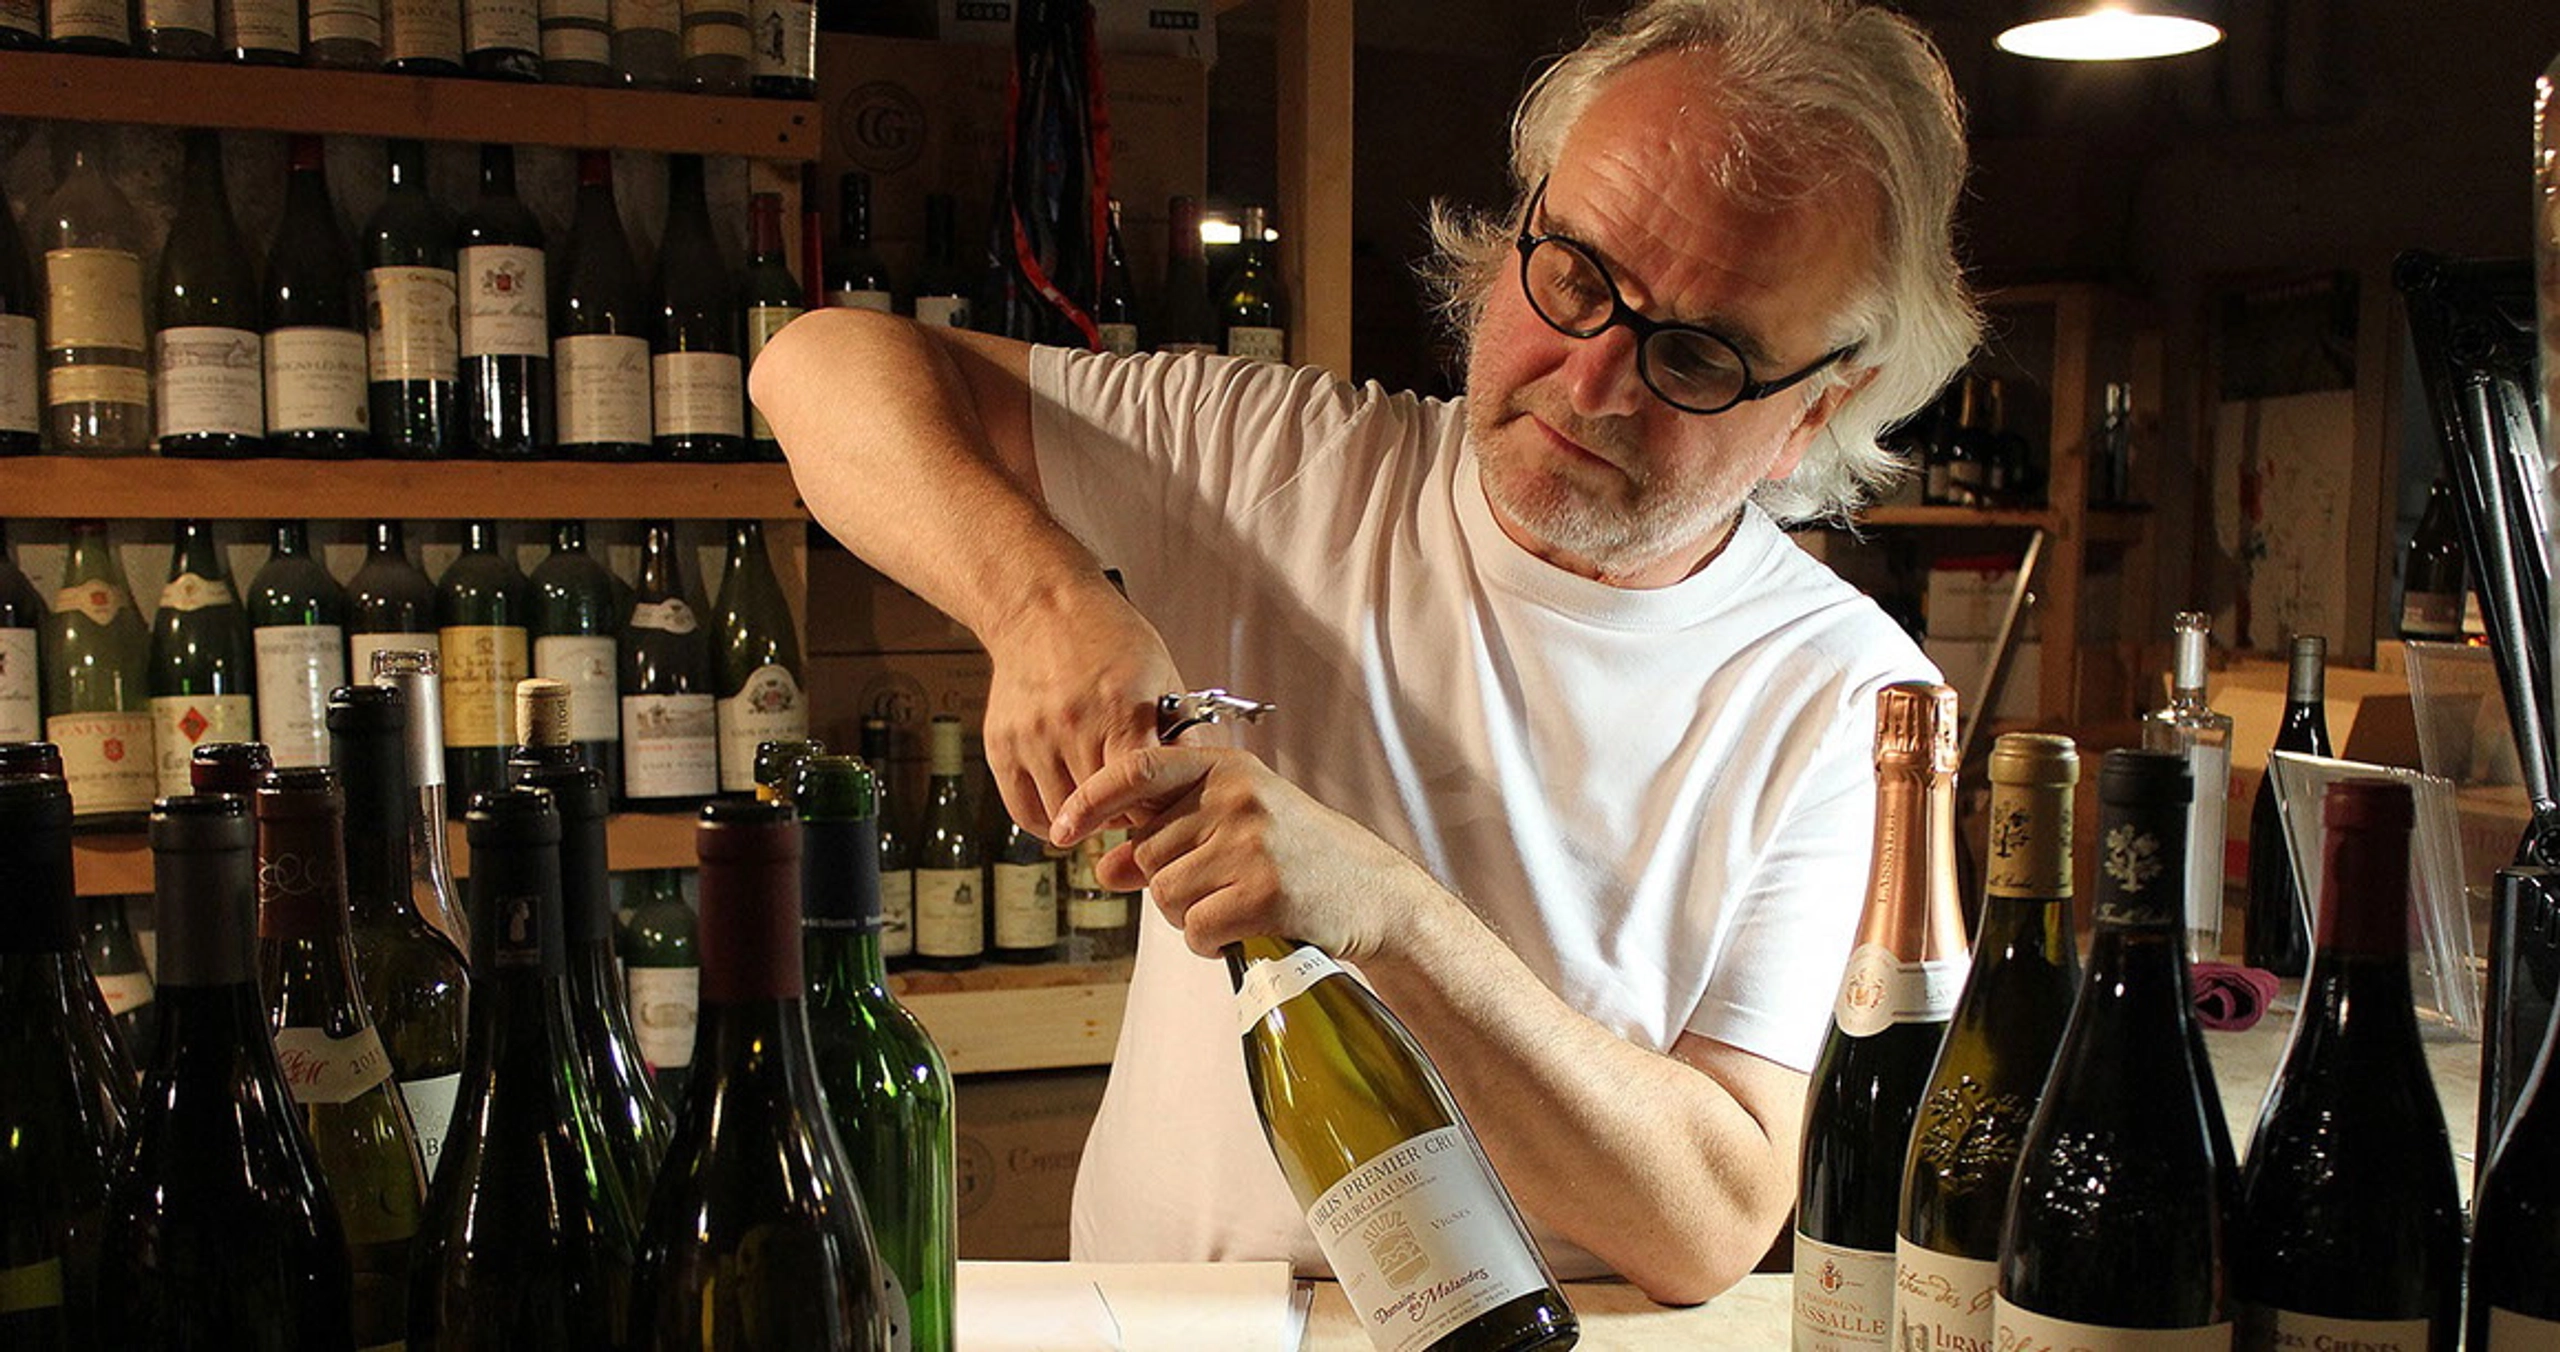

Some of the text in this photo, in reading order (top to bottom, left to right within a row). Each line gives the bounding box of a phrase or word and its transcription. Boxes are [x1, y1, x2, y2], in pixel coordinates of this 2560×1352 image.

[1342, 1145, 1422, 1201] PREMIER
[1424, 1133, 1457, 1156] CRU
[1328, 1168, 1422, 1236] FOURCHAUME
[1374, 1291, 1418, 1325] Domaine
